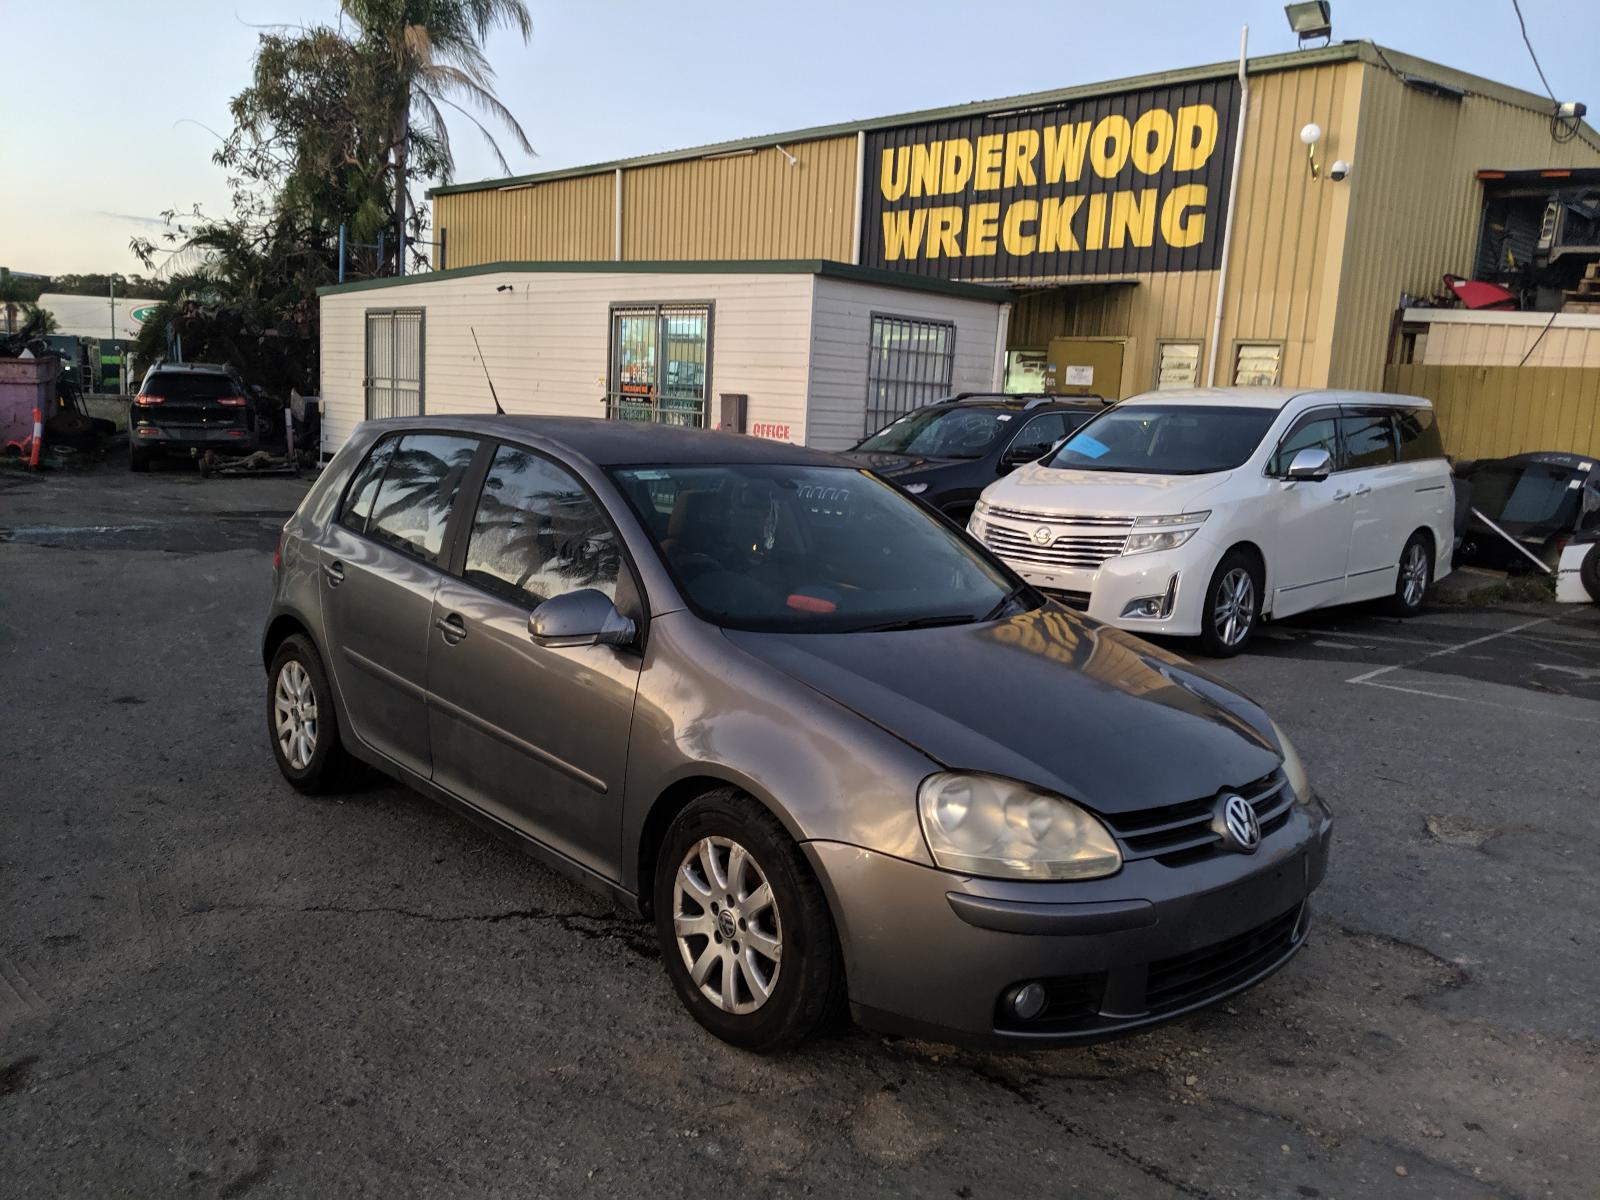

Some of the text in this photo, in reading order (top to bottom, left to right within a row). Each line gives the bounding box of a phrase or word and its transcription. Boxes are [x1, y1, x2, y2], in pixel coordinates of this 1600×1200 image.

[880, 103, 1219, 202] UNDERWOOD
[882, 183, 1209, 261] WRECKING
[752, 423, 790, 440] OFFICE
